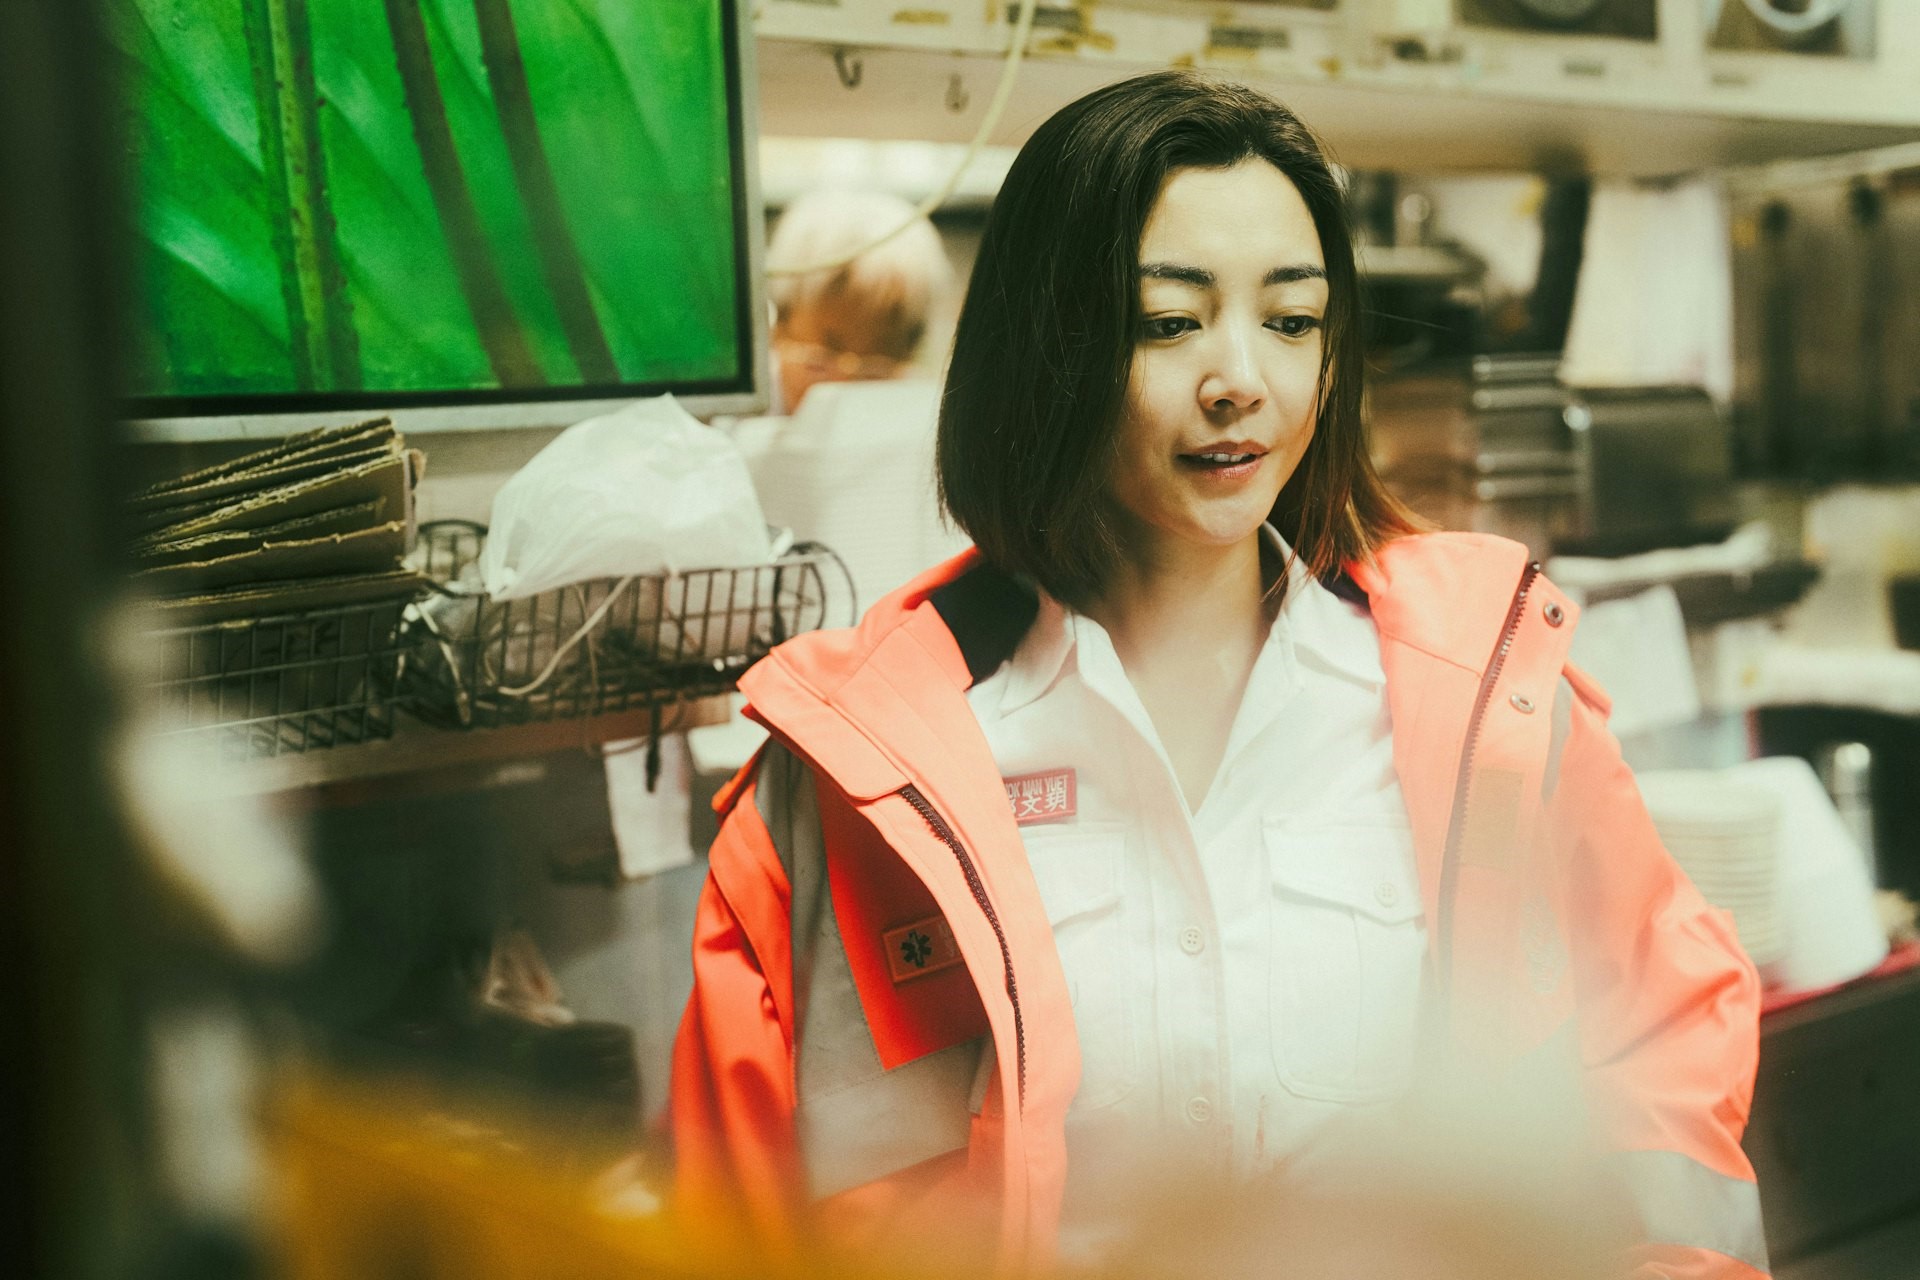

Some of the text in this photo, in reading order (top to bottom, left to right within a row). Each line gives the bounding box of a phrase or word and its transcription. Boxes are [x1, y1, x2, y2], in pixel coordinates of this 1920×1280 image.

[1005, 774, 1068, 799] OK MAN YUET
